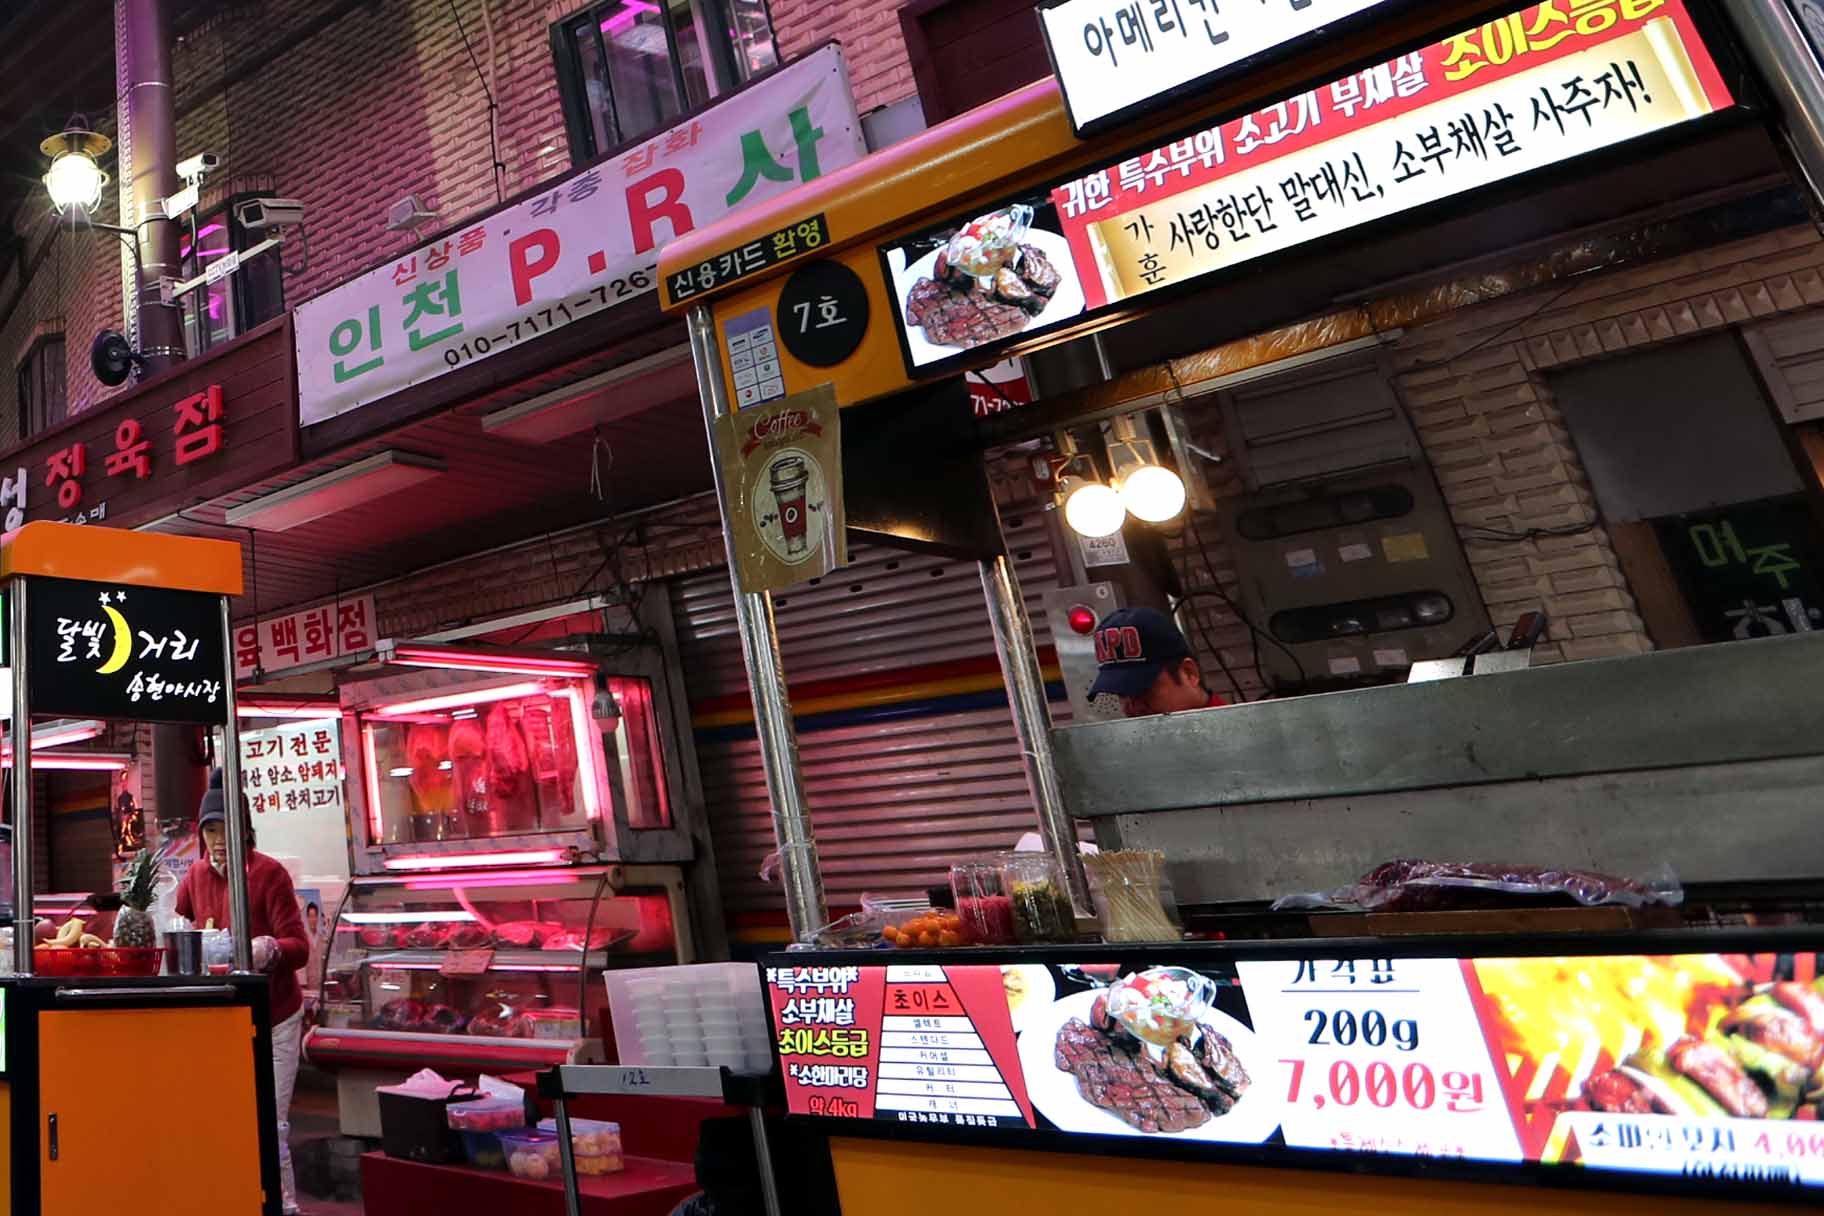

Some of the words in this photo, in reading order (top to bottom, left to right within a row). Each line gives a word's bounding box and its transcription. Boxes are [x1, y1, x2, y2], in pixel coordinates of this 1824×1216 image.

[1061, 164, 1113, 220] 귀한
[1118, 128, 1227, 199] 특수부위
[1232, 80, 1325, 157] 소고기
[1330, 49, 1429, 117] 부채살
[1168, 188, 1276, 259] 사랑한단
[1278, 150, 1387, 224] 말대신,
[1390, 100, 1517, 186] 소부채살
[1530, 58, 1654, 134] 사주자!
[390, 228, 487, 288] 신상품
[527, 172, 604, 220] 각종
[621, 121, 706, 179] 잡화
[673, 241, 767, 299] 신용카드
[771, 218, 823, 260] 환영
[326, 269, 466, 385] 인천
[791, 292, 849, 335] 7호
[753, 407, 802, 440] Coffee
[56, 616, 106, 663] 달빛
[138, 628, 201, 662] 거리
[125, 672, 221, 704] 송현야시장
[245, 739, 284, 760] 고기
[252, 792, 281, 814] 갈비
[284, 785, 342, 811] 잔치고기
[781, 997, 857, 1026] 소부채살
[893, 988, 951, 1011] 초이스
[778, 1028, 869, 1059] 초이스등급
[1303, 1009, 1420, 1052] 200g
[1277, 1059, 1485, 1114] 7,000원
